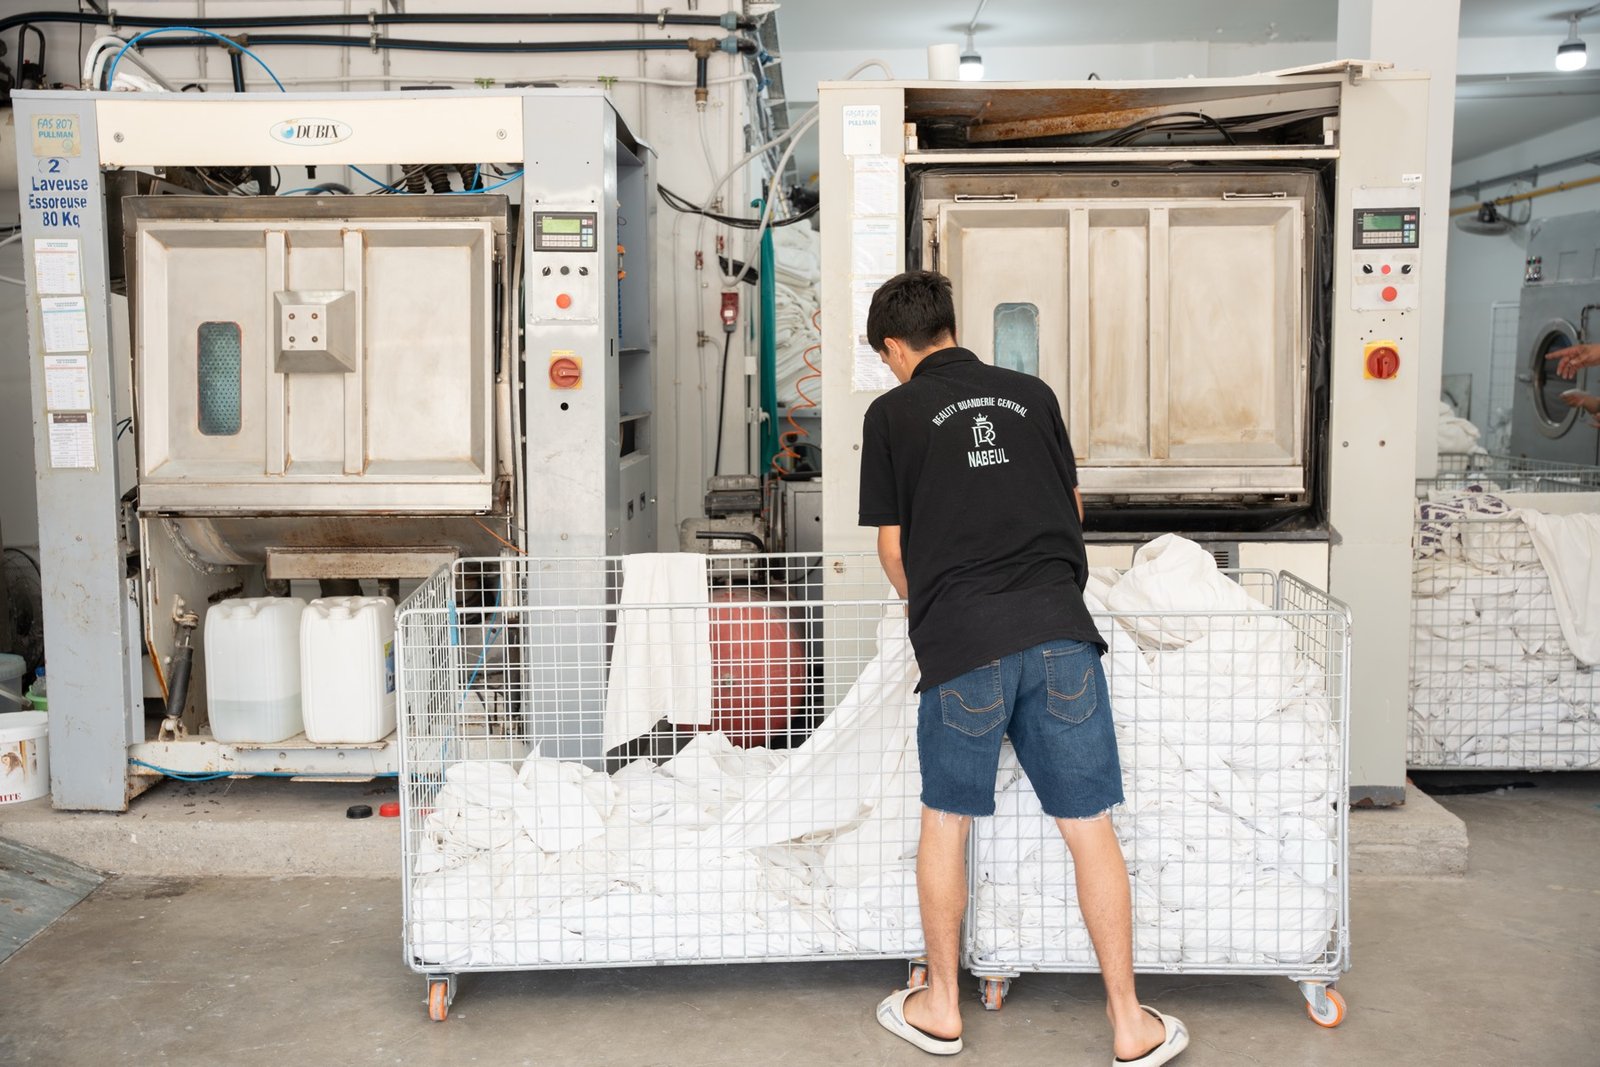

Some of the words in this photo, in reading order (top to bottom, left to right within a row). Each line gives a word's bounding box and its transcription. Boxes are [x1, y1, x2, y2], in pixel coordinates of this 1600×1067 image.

[37, 118, 54, 129] FAS
[56, 118, 73, 130] 807
[296, 124, 339, 139] DUBIX
[38, 131, 74, 139] PULLMAN
[48, 158, 61, 173] 2
[31, 176, 88, 191] Laveuse
[28, 193, 87, 210] Essoreuse
[43, 211, 58, 227] 80
[932, 403, 958, 427] REALITY
[957, 397, 996, 411] BUANDERIE
[997, 398, 1028, 418] CENTRAL
[967, 447, 1010, 468] NABEUL
